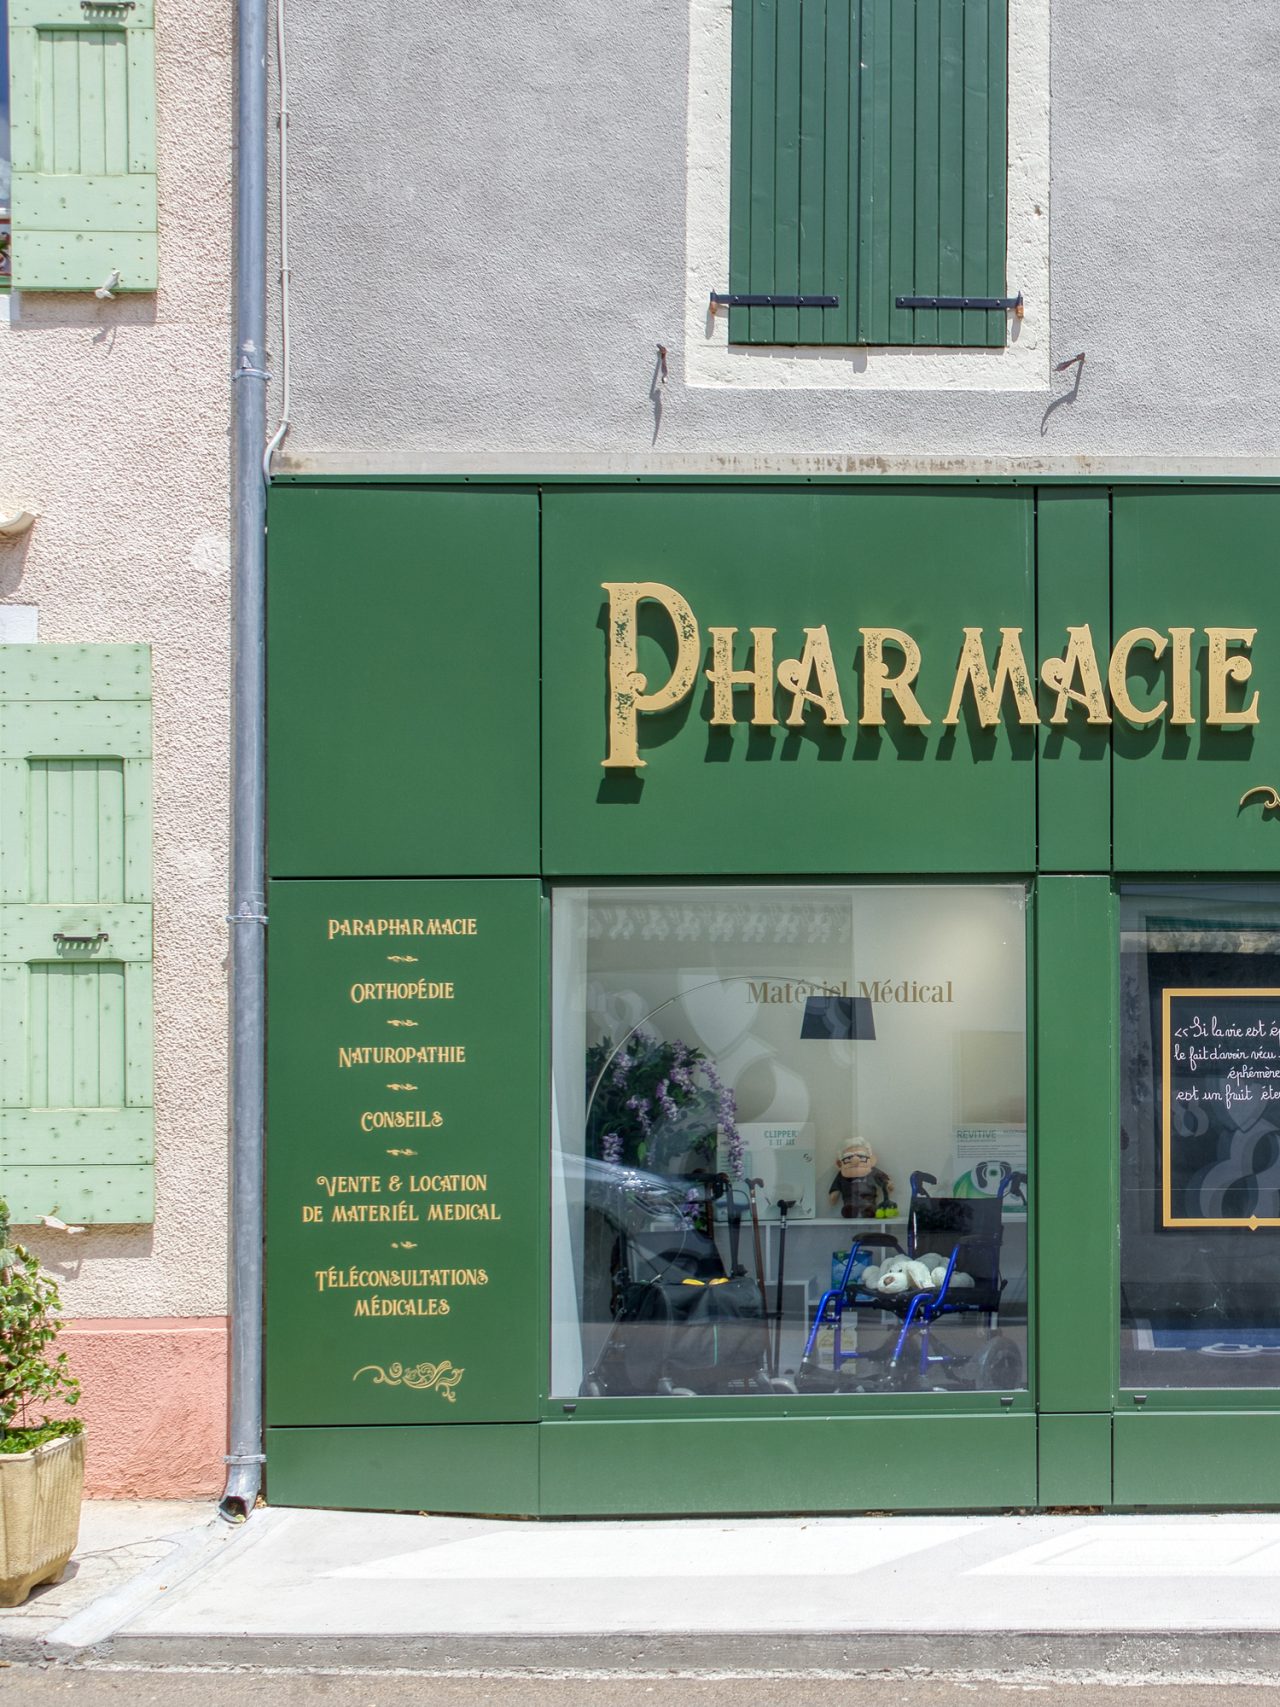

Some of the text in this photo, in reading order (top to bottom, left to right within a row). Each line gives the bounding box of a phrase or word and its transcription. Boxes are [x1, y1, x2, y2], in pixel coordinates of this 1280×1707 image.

[601, 581, 1261, 768] PHARMACIE
[328, 918, 478, 939] PARAPHARMACIE
[350, 979, 455, 1003] ORTHOPÉDIE
[857, 979, 955, 1003] Médical
[1245, 1020, 1266, 1037] est
[338, 1046, 466, 1068] NATUROPATHIE
[1174, 1044, 1186, 1060] le
[1189, 1047, 1209, 1070] fait
[1176, 1085, 1199, 1100] est
[1202, 1091, 1222, 1100] un
[1226, 1084, 1253, 1109] fruit
[361, 1111, 443, 1132] CONSEILS
[317, 1175, 488, 1197] VENTE & LOCATION
[302, 1201, 501, 1222] DE MATERIÉL MEDICAL
[315, 1266, 489, 1292] TÉLÉCONSULTATIONS
[354, 1295, 450, 1317] MÉDICALES
